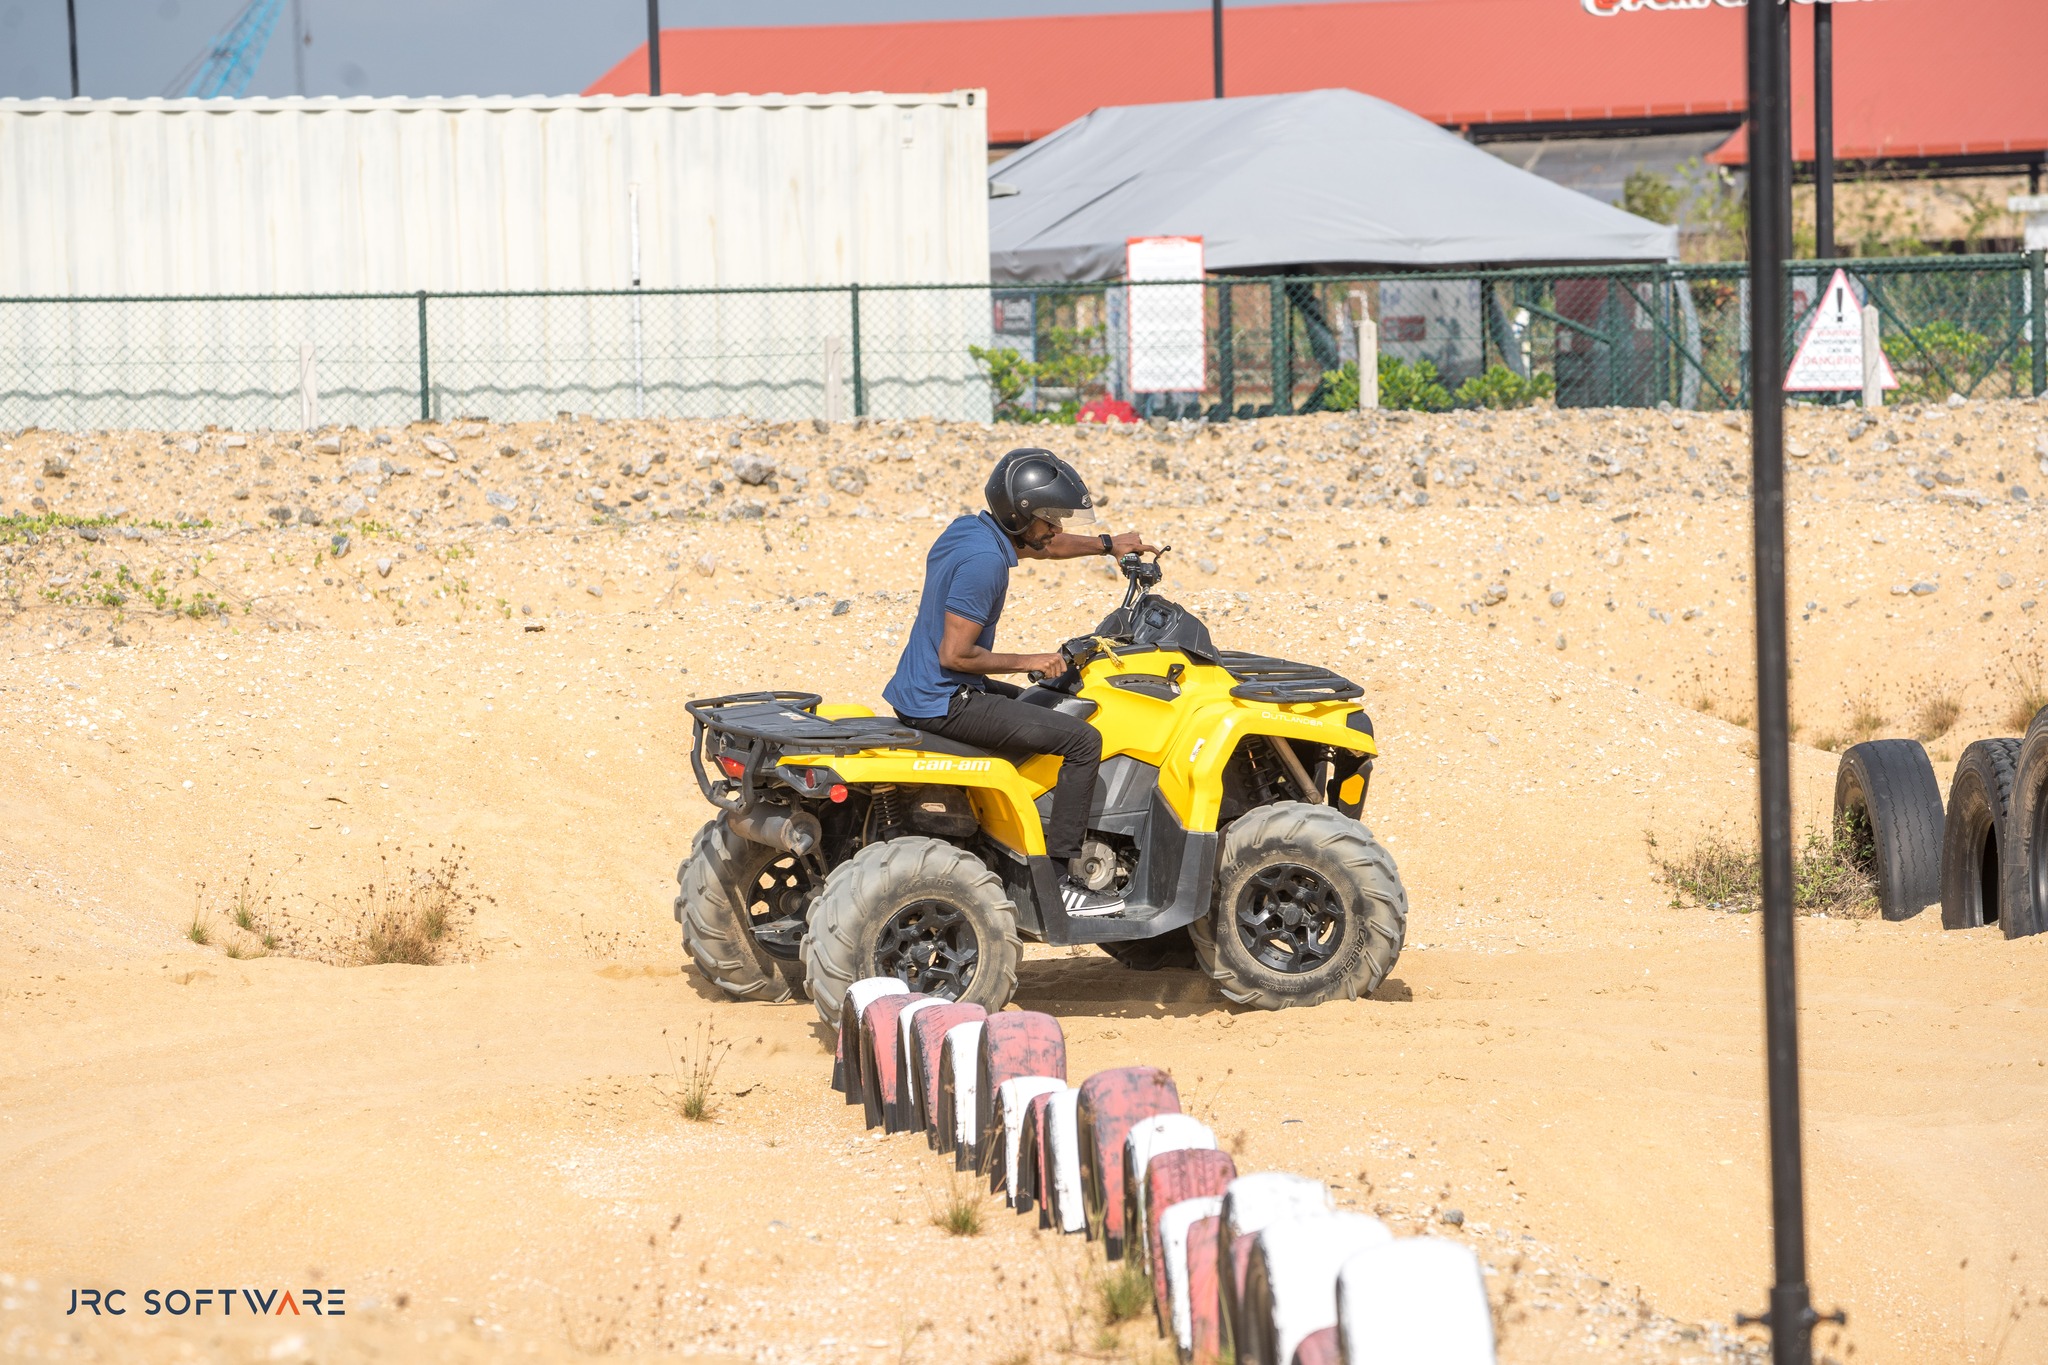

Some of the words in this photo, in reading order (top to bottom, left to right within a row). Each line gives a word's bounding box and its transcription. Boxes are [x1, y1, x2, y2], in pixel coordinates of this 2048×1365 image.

[1802, 355, 1862, 365] DANGERO
[1261, 711, 1324, 727] OUTLANDER
[912, 760, 992, 772] can-am
[1333, 928, 1368, 983] CARLISLE
